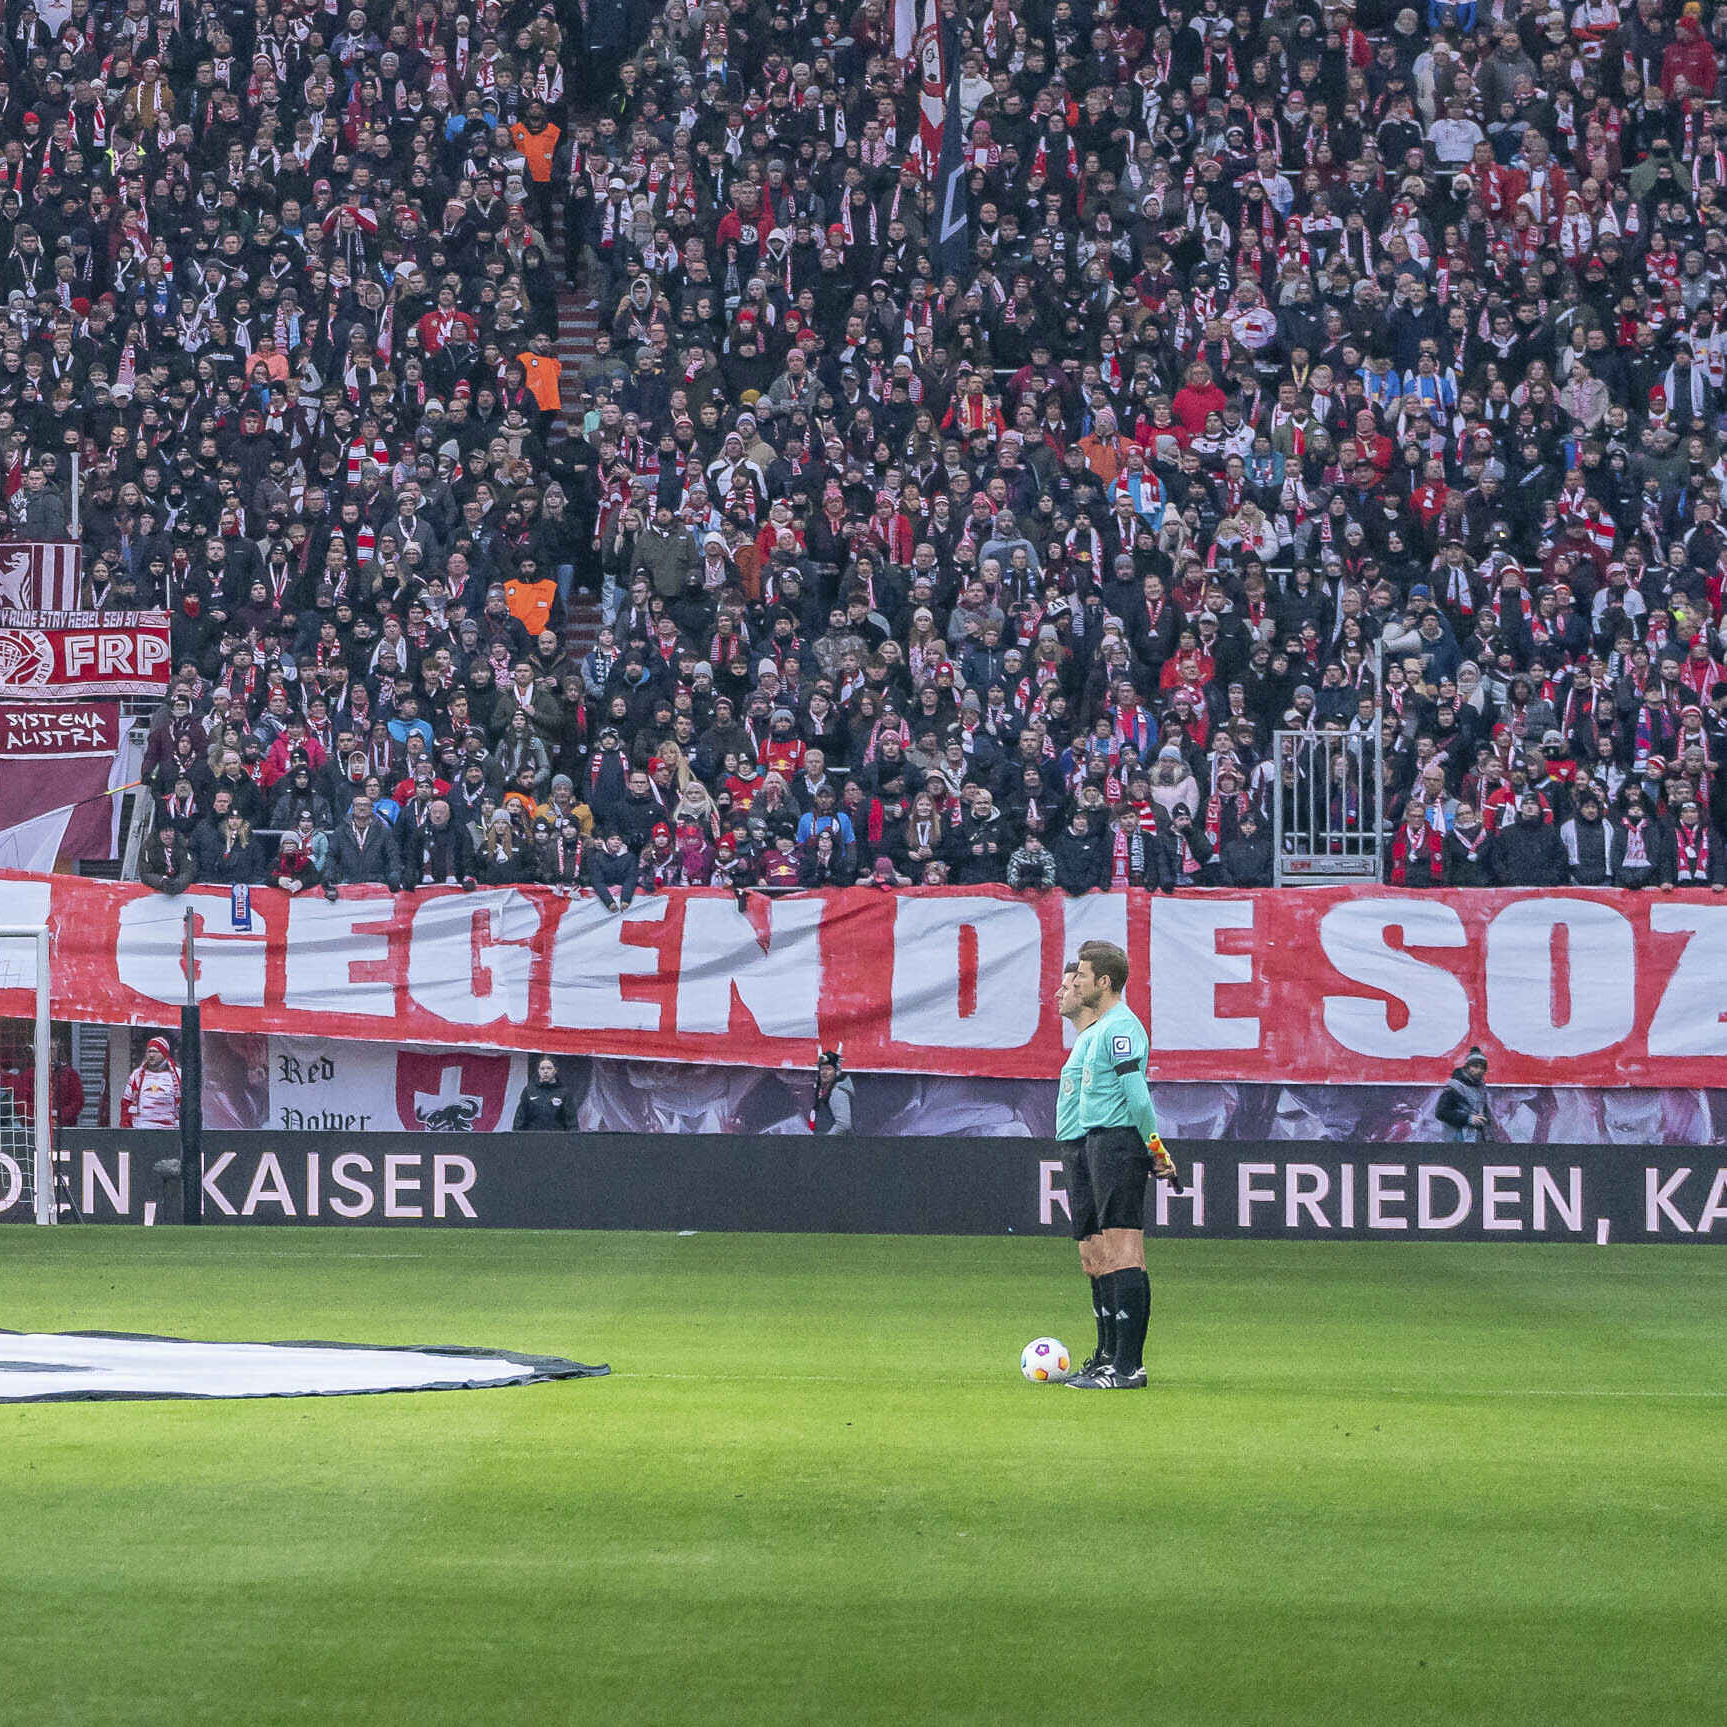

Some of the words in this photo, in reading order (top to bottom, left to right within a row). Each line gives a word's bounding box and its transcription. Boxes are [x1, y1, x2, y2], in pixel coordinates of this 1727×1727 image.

[64, 634, 171, 677] FRP
[5, 712, 107, 730] SYSTEMA
[116, 888, 823, 1039] GEGEN
[277, 1054, 335, 1084] Red
[280, 1106, 372, 1131] Power
[199, 1151, 479, 1219] KAISER
[1039, 1160, 1205, 1227] RH
[1238, 1160, 1610, 1245] FRIEDEN,
